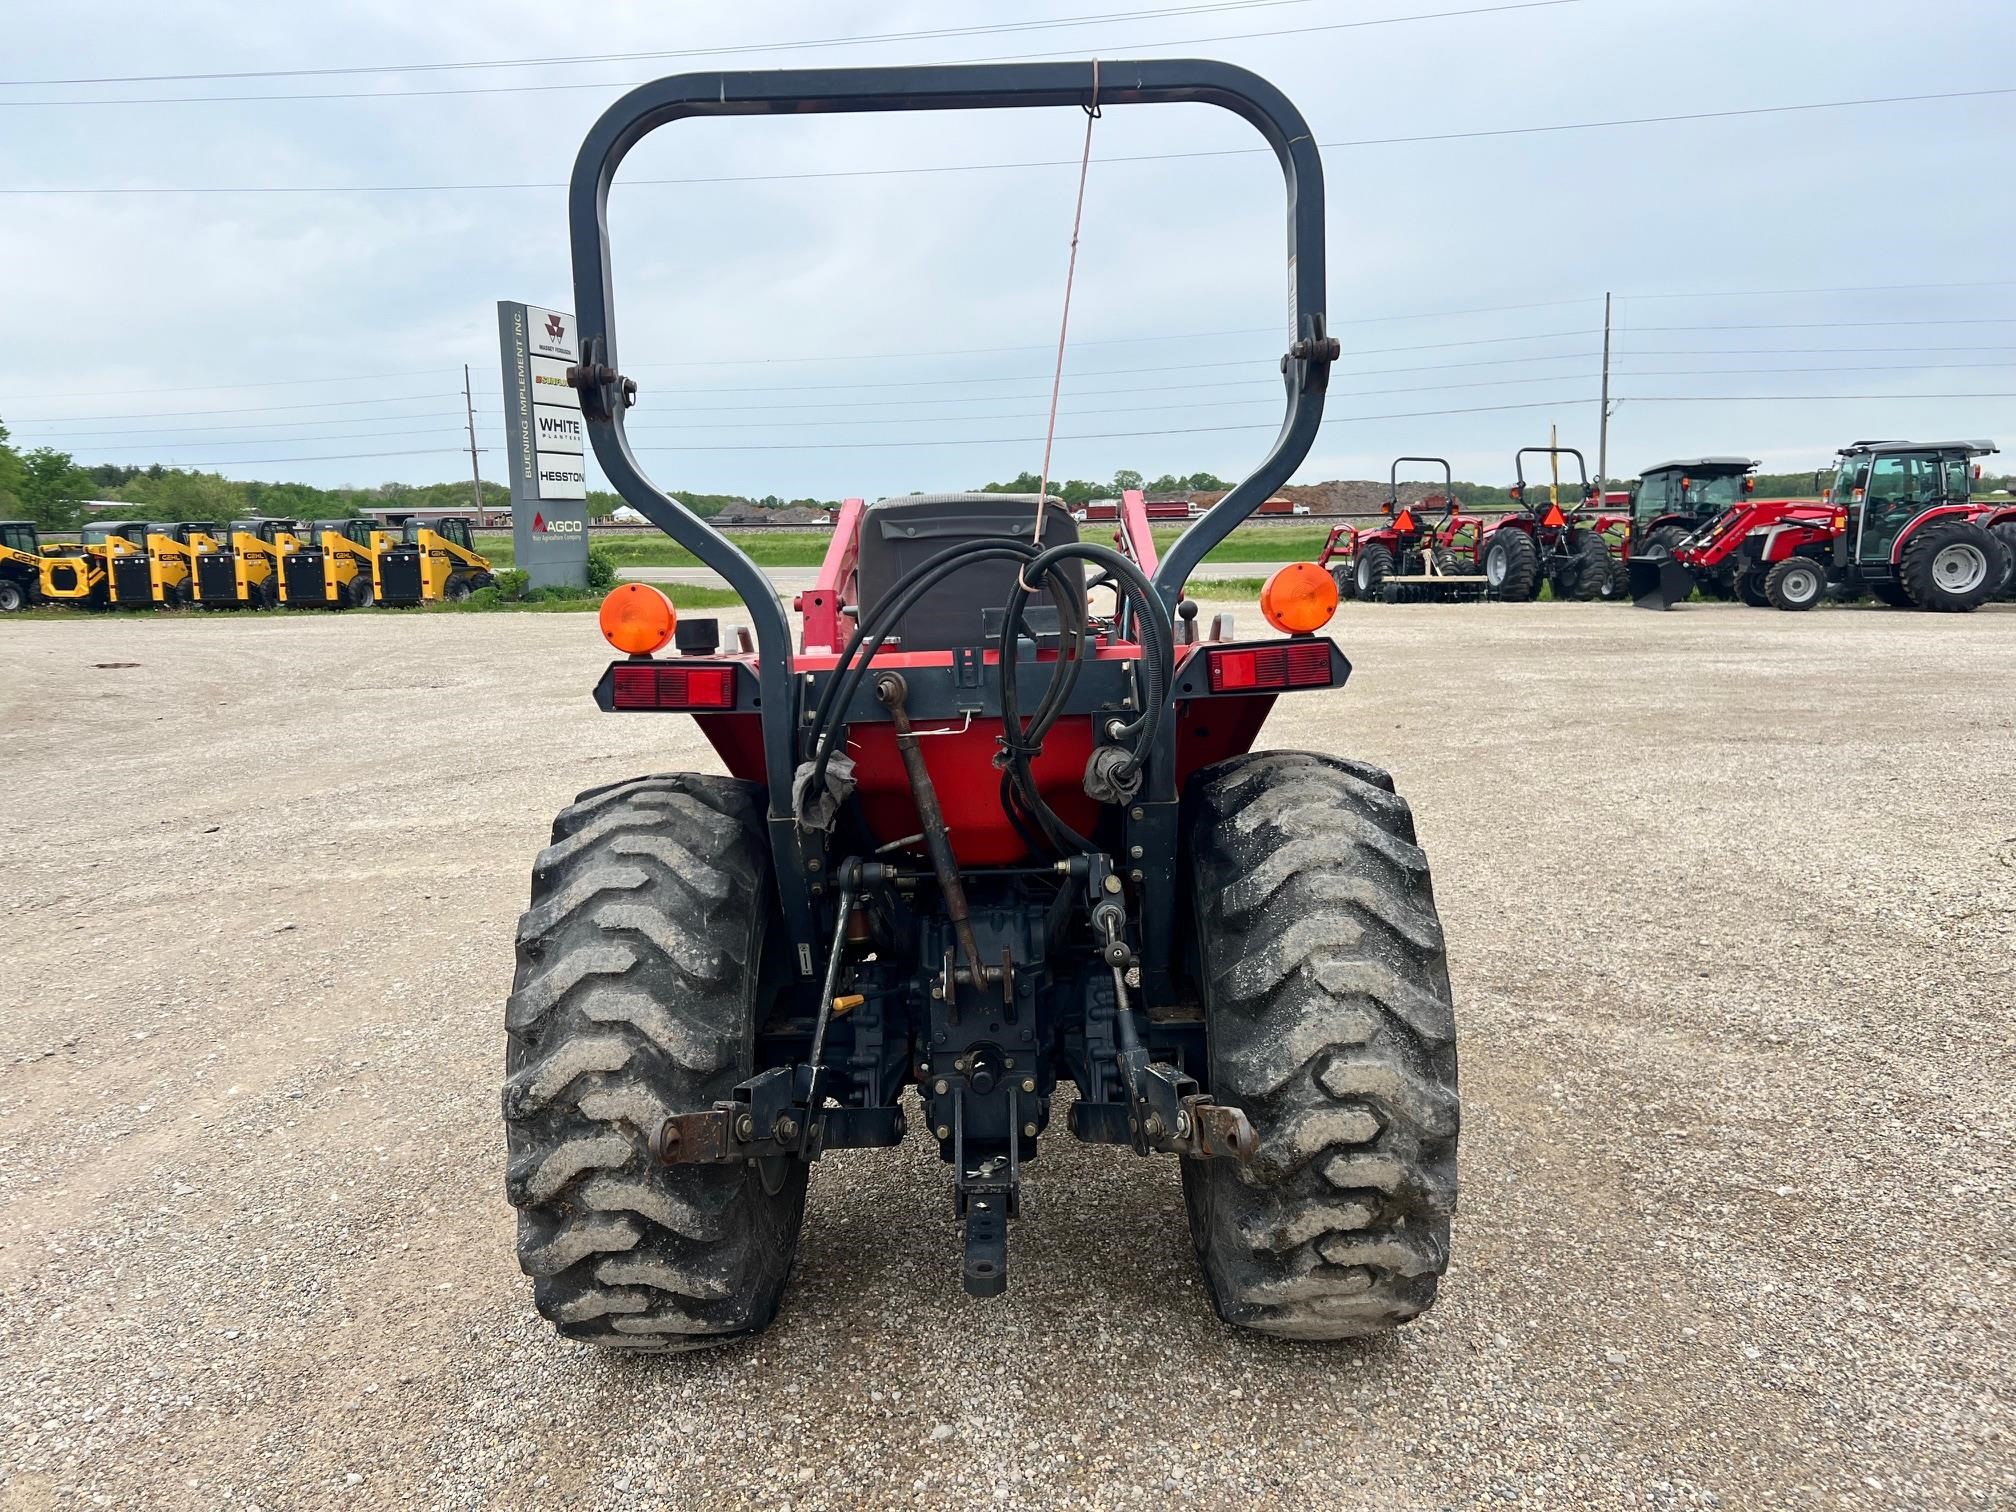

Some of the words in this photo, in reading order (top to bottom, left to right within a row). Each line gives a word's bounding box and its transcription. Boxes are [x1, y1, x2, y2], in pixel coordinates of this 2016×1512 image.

[516, 339, 528, 416] IMPLEMENT
[539, 418, 580, 434] WHITE
[521, 420, 532, 479] BUENING
[540, 471, 584, 482] HESSTON
[547, 521, 582, 532] AGCO
